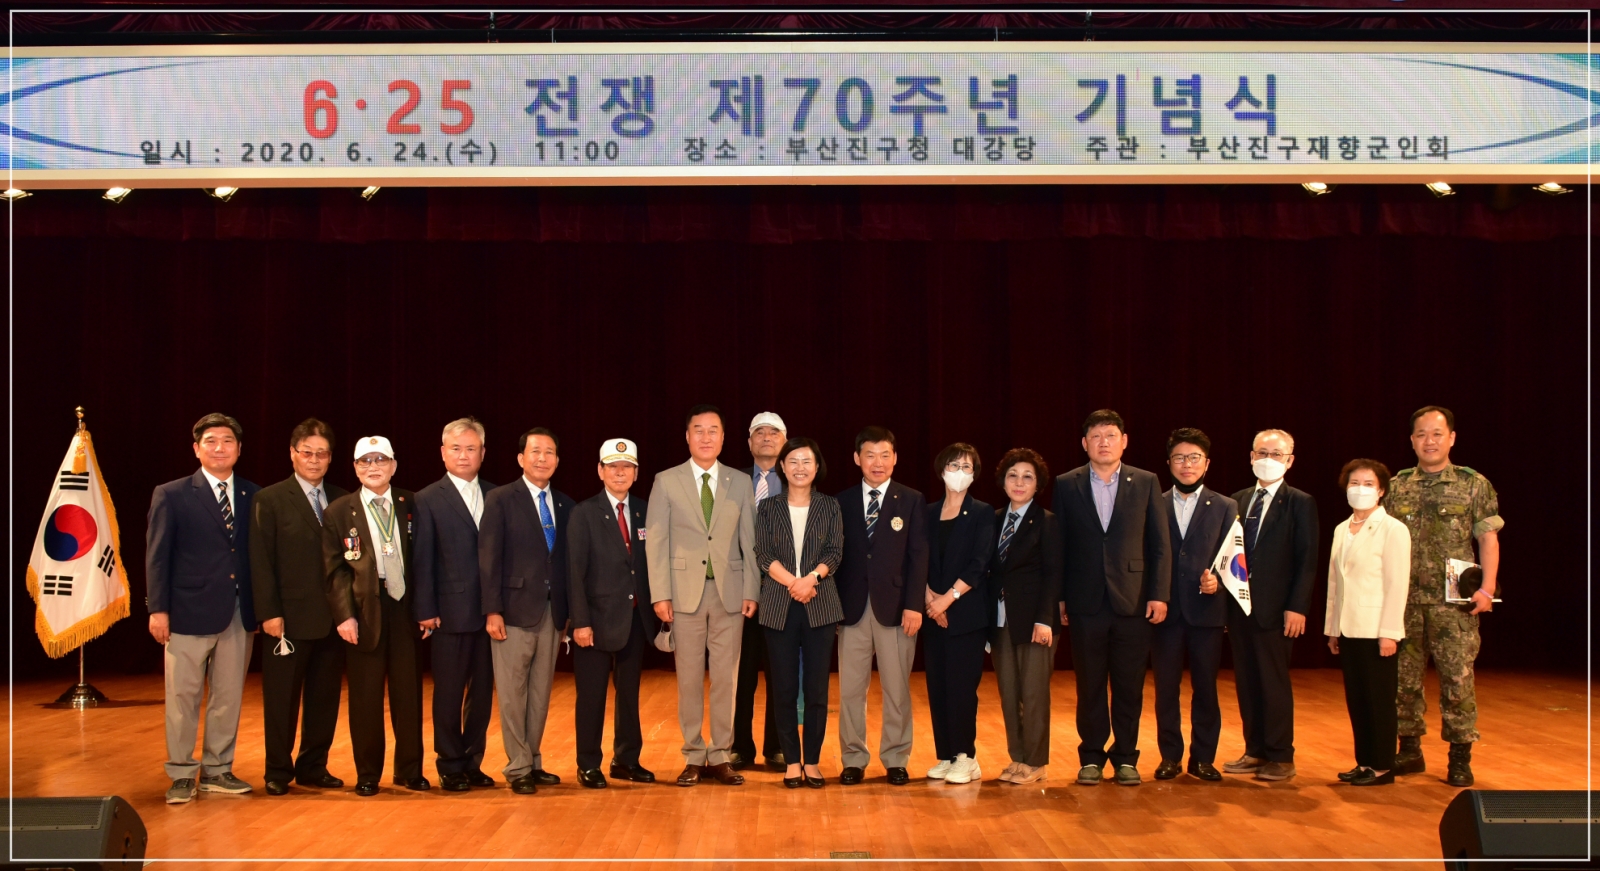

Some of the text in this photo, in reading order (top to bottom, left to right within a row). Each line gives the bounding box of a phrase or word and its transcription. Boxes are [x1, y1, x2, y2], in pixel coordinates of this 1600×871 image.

[524, 75, 655, 138] 전쟁
[708, 74, 1019, 138] 제70주년
[1075, 74, 1277, 137] 기념식
[140, 139, 191, 165] 일시
[241, 142, 325, 162] 2020.
[346, 142, 372, 162] 6.
[394, 139, 497, 165] 24.(수)
[535, 141, 619, 161] 11:00
[684, 137, 737, 162] 장소
[786, 137, 928, 161] 부산진구청
[953, 136, 1036, 161] 대강당
[1087, 136, 1139, 160] 주관
[1187, 136, 1449, 160] 부산진구재향군인회
